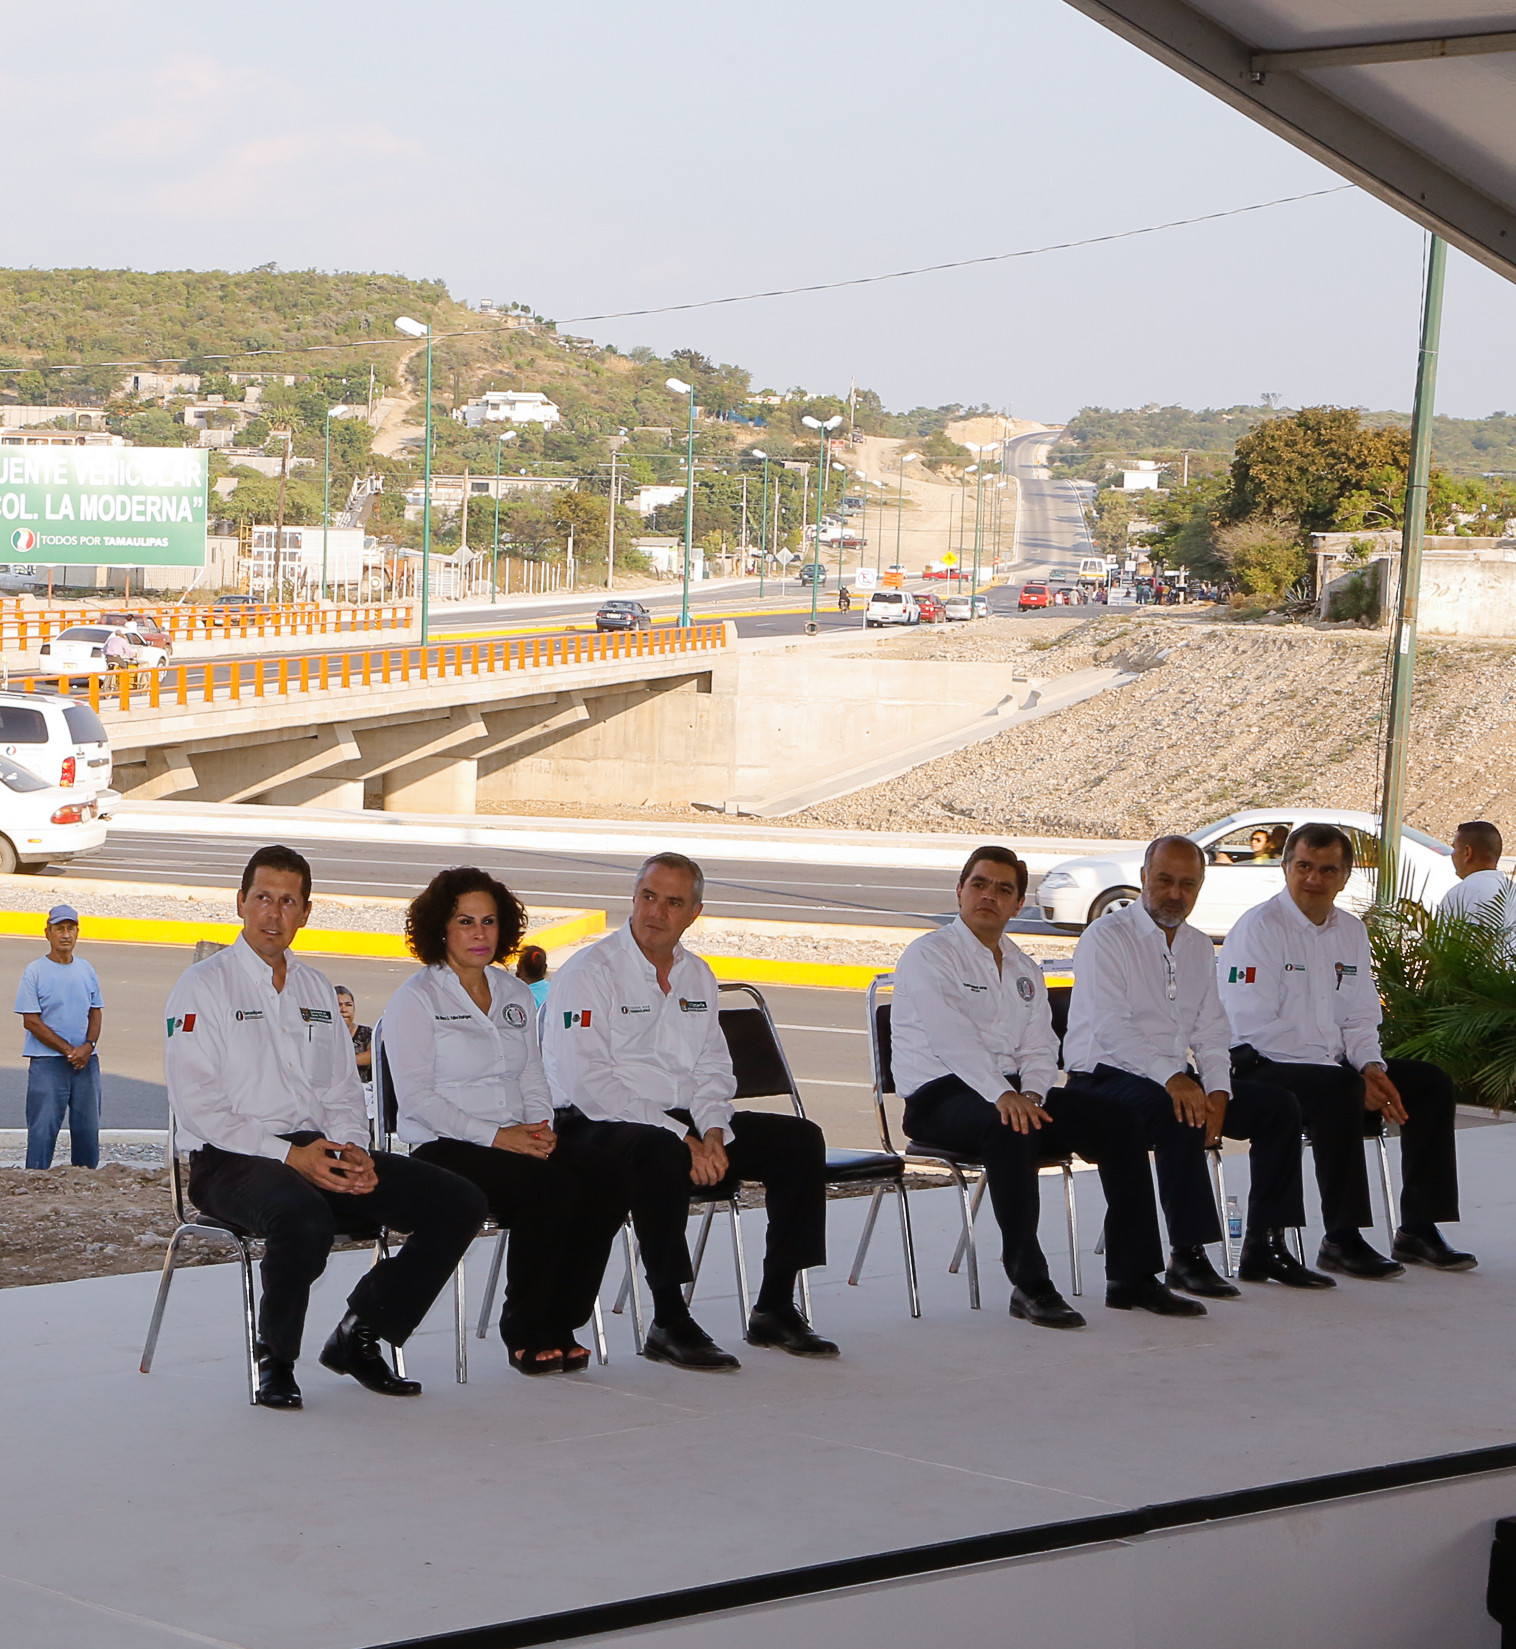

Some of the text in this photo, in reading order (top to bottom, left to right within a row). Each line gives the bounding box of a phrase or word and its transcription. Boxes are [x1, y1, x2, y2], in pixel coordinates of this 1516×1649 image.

[74, 459, 202, 488] VEHICULAR
[45, 493, 75, 521] LA
[41, 535, 169, 548] TODOS POR TAMAULIPAS
